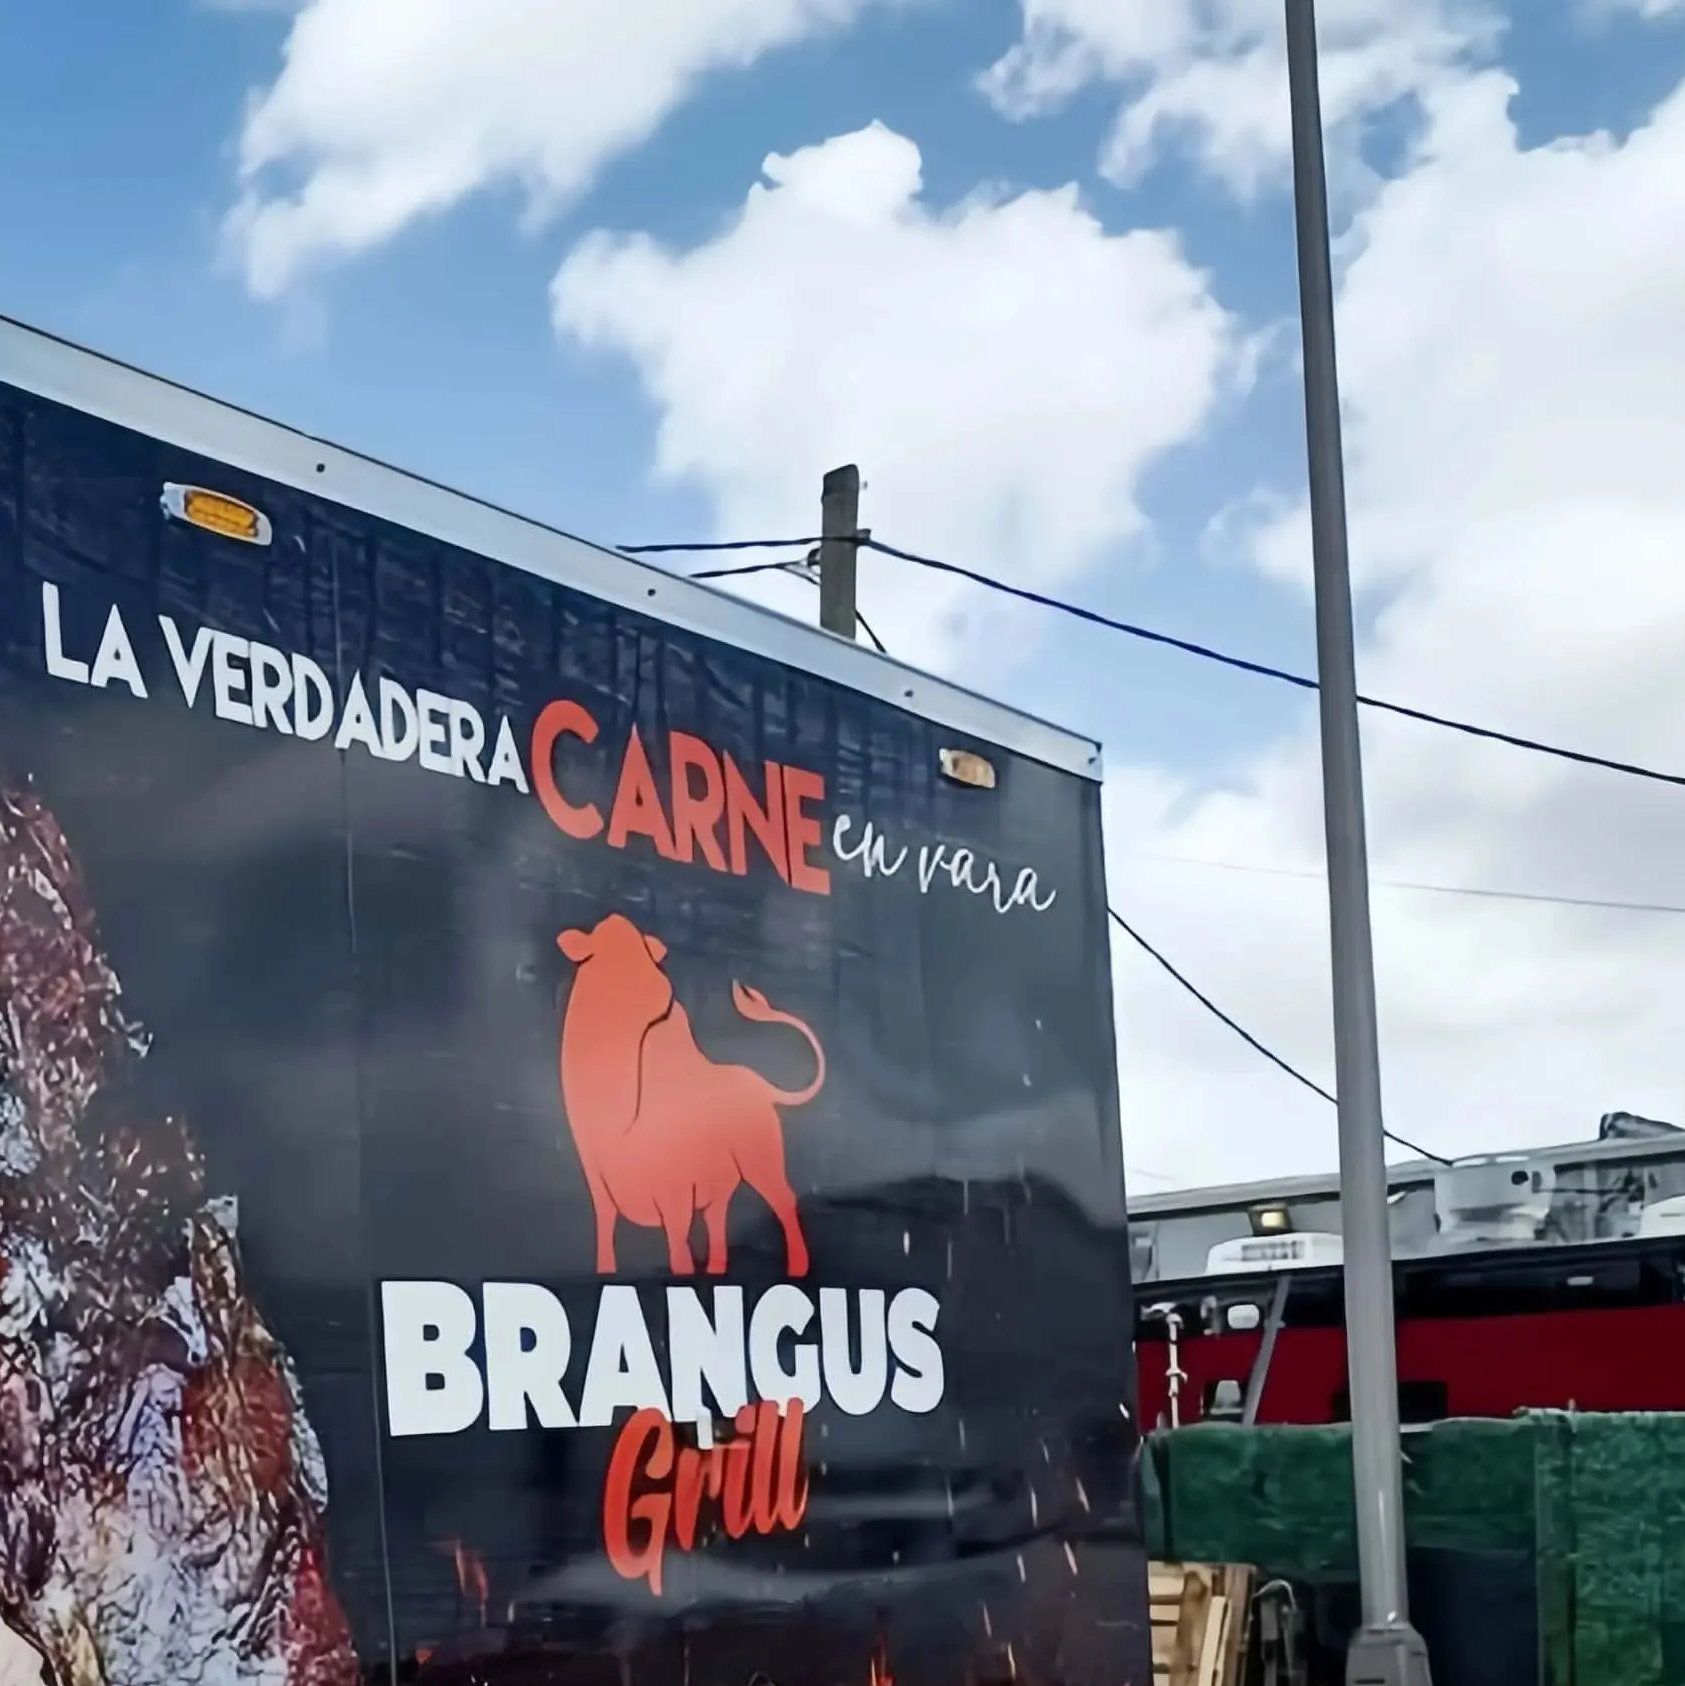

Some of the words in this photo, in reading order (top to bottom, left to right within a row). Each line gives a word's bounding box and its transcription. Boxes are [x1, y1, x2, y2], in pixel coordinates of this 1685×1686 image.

[42, 581, 149, 698] LA
[158, 614, 530, 795] VERDADERA
[531, 699, 832, 895] CARNE
[835, 812, 909, 878] en
[919, 843, 1057, 914] vara
[381, 1280, 945, 1437] BRANGUS
[604, 1398, 809, 1596] Grill
